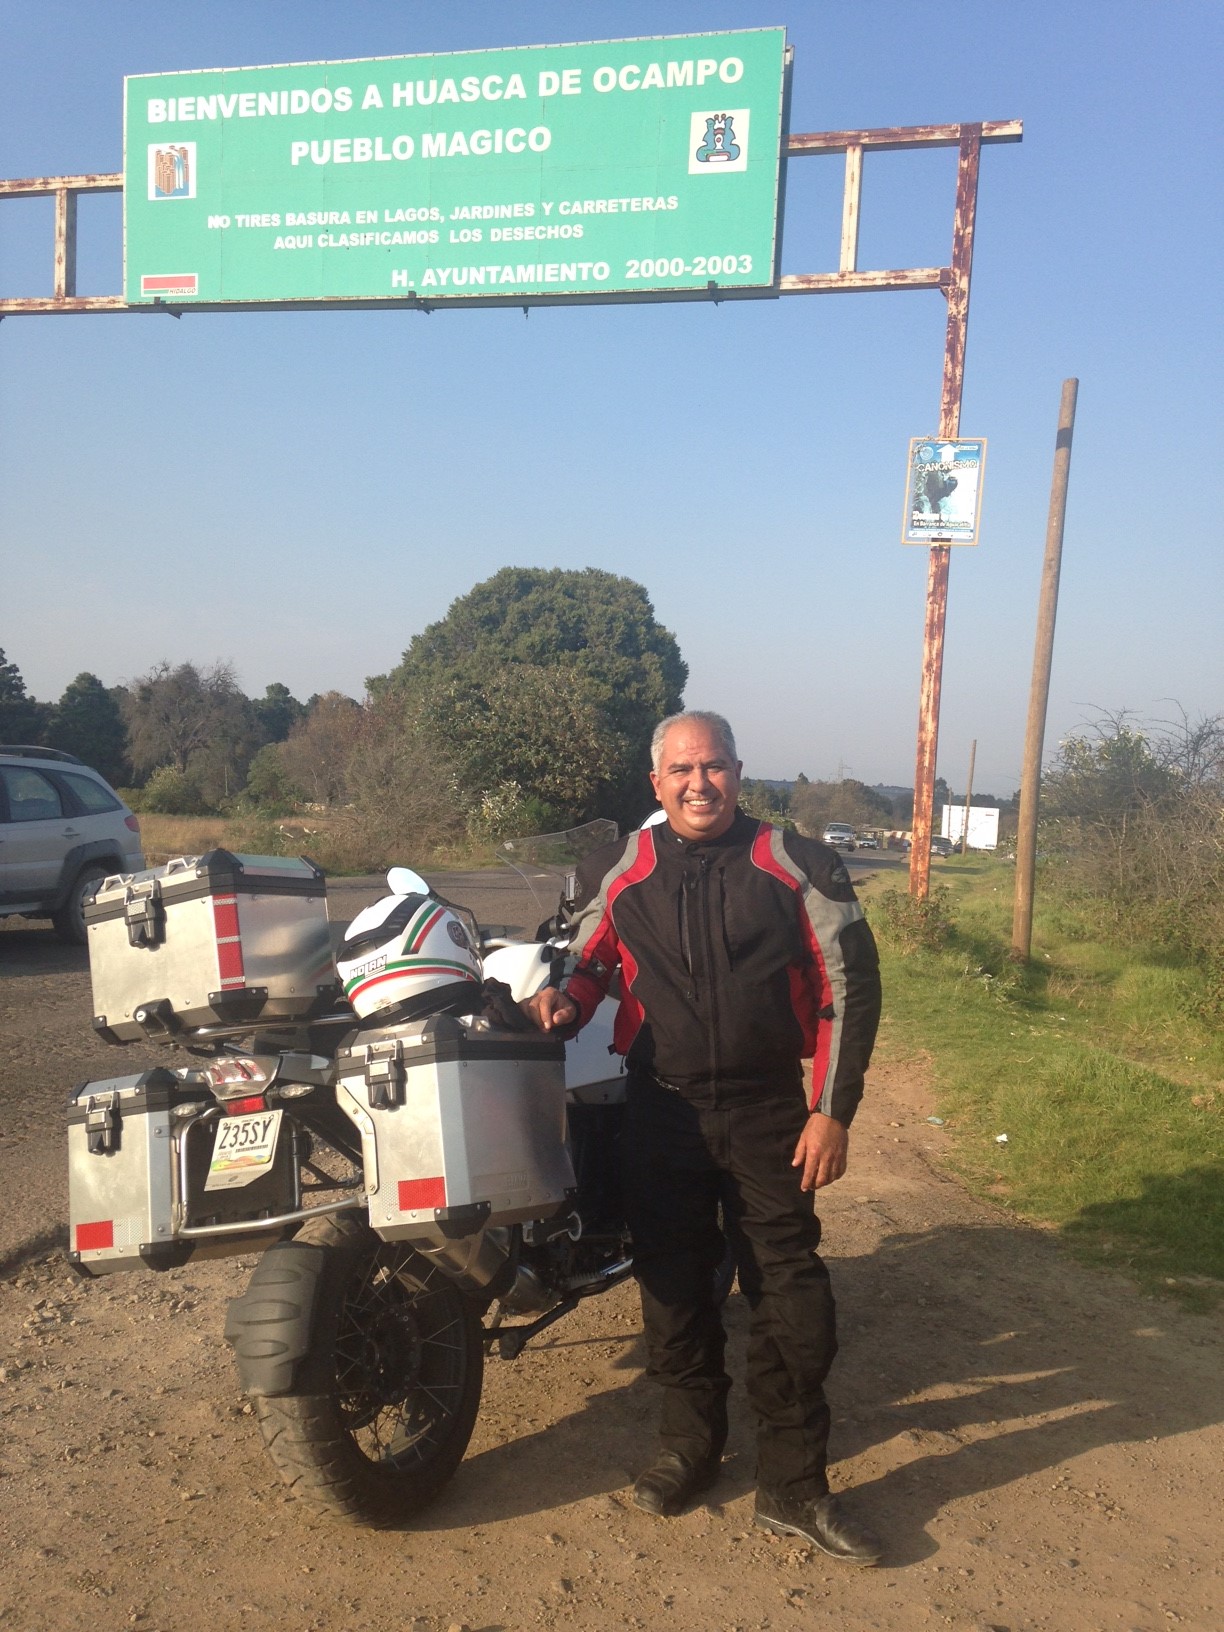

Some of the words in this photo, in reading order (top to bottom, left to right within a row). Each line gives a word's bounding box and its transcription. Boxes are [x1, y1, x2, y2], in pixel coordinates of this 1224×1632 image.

[147, 86, 353, 123] BIENVENIDOS
[361, 84, 384, 110] A
[392, 74, 527, 107] HUASCA
[538, 69, 581, 97] DE
[593, 57, 744, 92] OCAMPO
[291, 135, 414, 166] PUEBLO
[421, 126, 551, 159] MAGICO
[207, 214, 232, 229] NO
[235, 212, 281, 228] TIRES
[285, 210, 351, 226] BASURA
[355, 210, 378, 224] EN
[384, 206, 445, 224] LAGOS,
[449, 203, 535, 220] JARDINES
[542, 202, 554, 216] Y
[559, 195, 678, 215] CARRETERAS
[273, 234, 313, 250] AQUI
[317, 229, 439, 248] CLASIFICAMOS
[448, 228, 482, 244] LOS
[490, 223, 584, 242] DESECHOS
[391, 269, 415, 288] H.
[421, 261, 610, 286] AYUNTAMIENTO
[625, 255, 752, 279] 2000-2003
[350, 954, 387, 980] NOLAN
[218, 1116, 274, 1150] Z35SY
